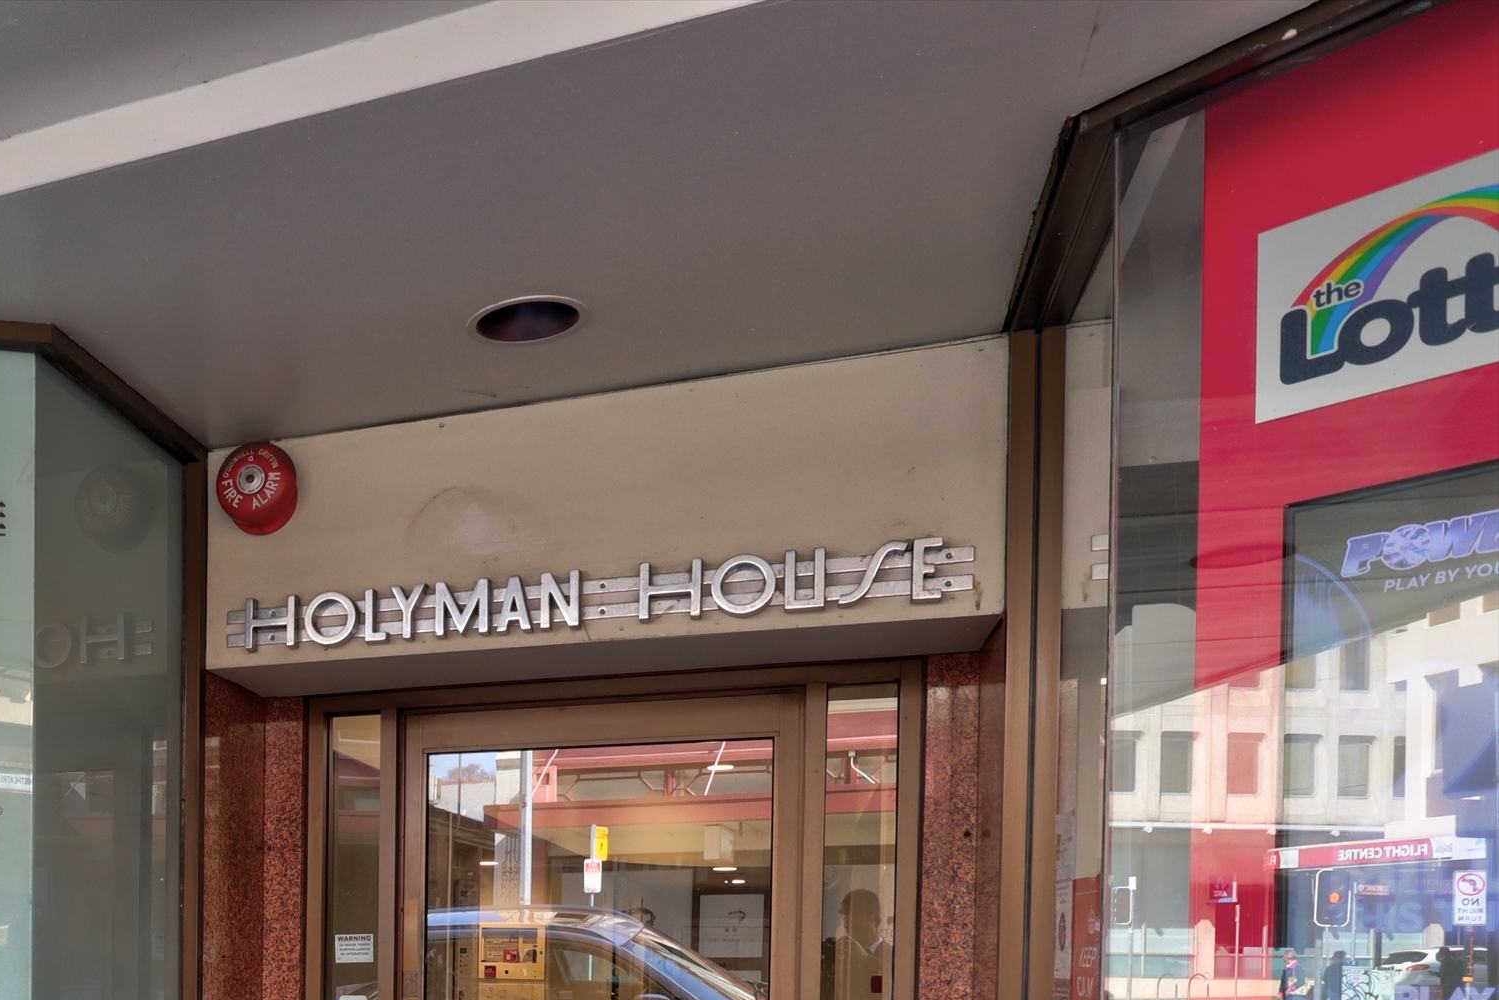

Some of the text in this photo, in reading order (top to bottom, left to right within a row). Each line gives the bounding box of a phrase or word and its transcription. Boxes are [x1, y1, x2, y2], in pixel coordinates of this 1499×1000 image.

[1312, 281, 1362, 308] the
[1279, 252, 1499, 385] Lott
[257, 448, 280, 469] GRIFFIN
[221, 478, 244, 509] FIRE
[252, 471, 282, 510] ALARM
[244, 536, 944, 652] HOLYMAN HOUSE
[1383, 572, 1431, 593] PLAY
[1434, 568, 1461, 585] BY
[1078, 946, 1098, 968] KEEP
